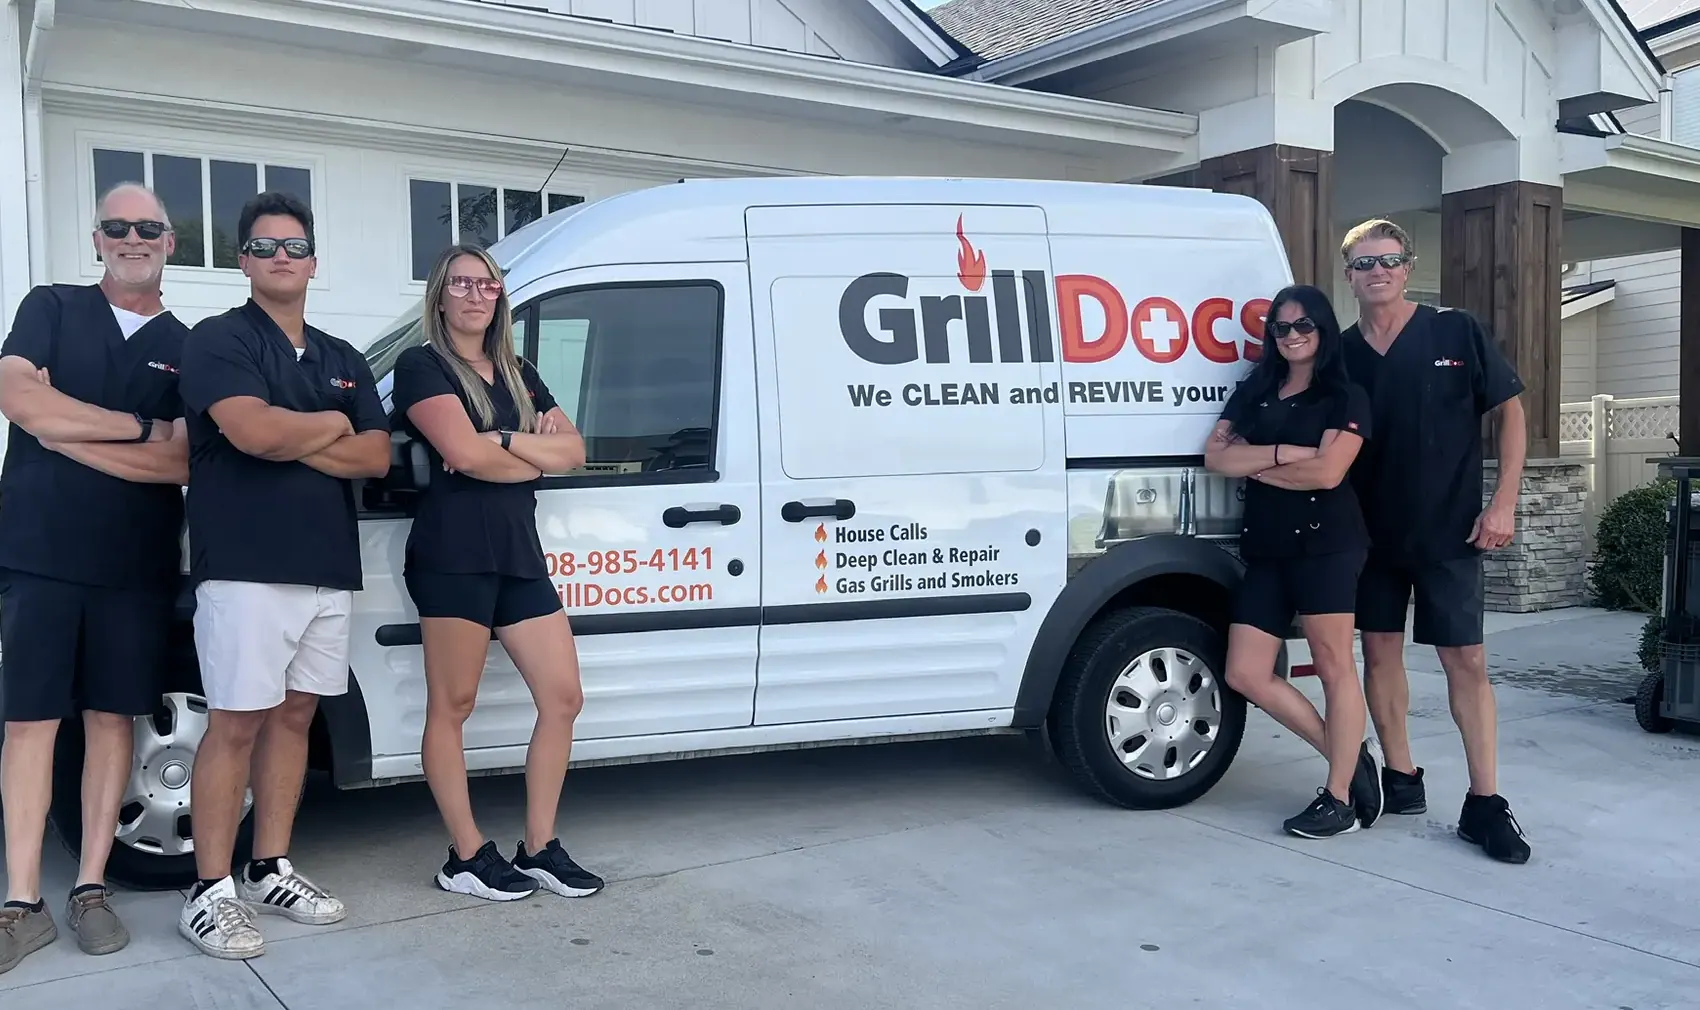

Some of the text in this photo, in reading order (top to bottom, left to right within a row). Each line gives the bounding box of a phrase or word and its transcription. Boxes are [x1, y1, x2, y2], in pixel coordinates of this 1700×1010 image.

[838, 268, 1276, 365] GrillDocs
[847, 384, 892, 407] We
[902, 382, 1000, 407] CLEAN
[1009, 381, 1060, 405] and
[1068, 381, 1164, 403] REVIVE
[1172, 385, 1228, 407] your
[835, 522, 928, 543] House Calls
[544, 546, 713, 577] 08-985-4141
[836, 545, 1000, 572] Deep Clean & Repair
[836, 569, 1019, 594] Gas Grills and Smokers
[558, 582, 713, 608] illDocs.com
